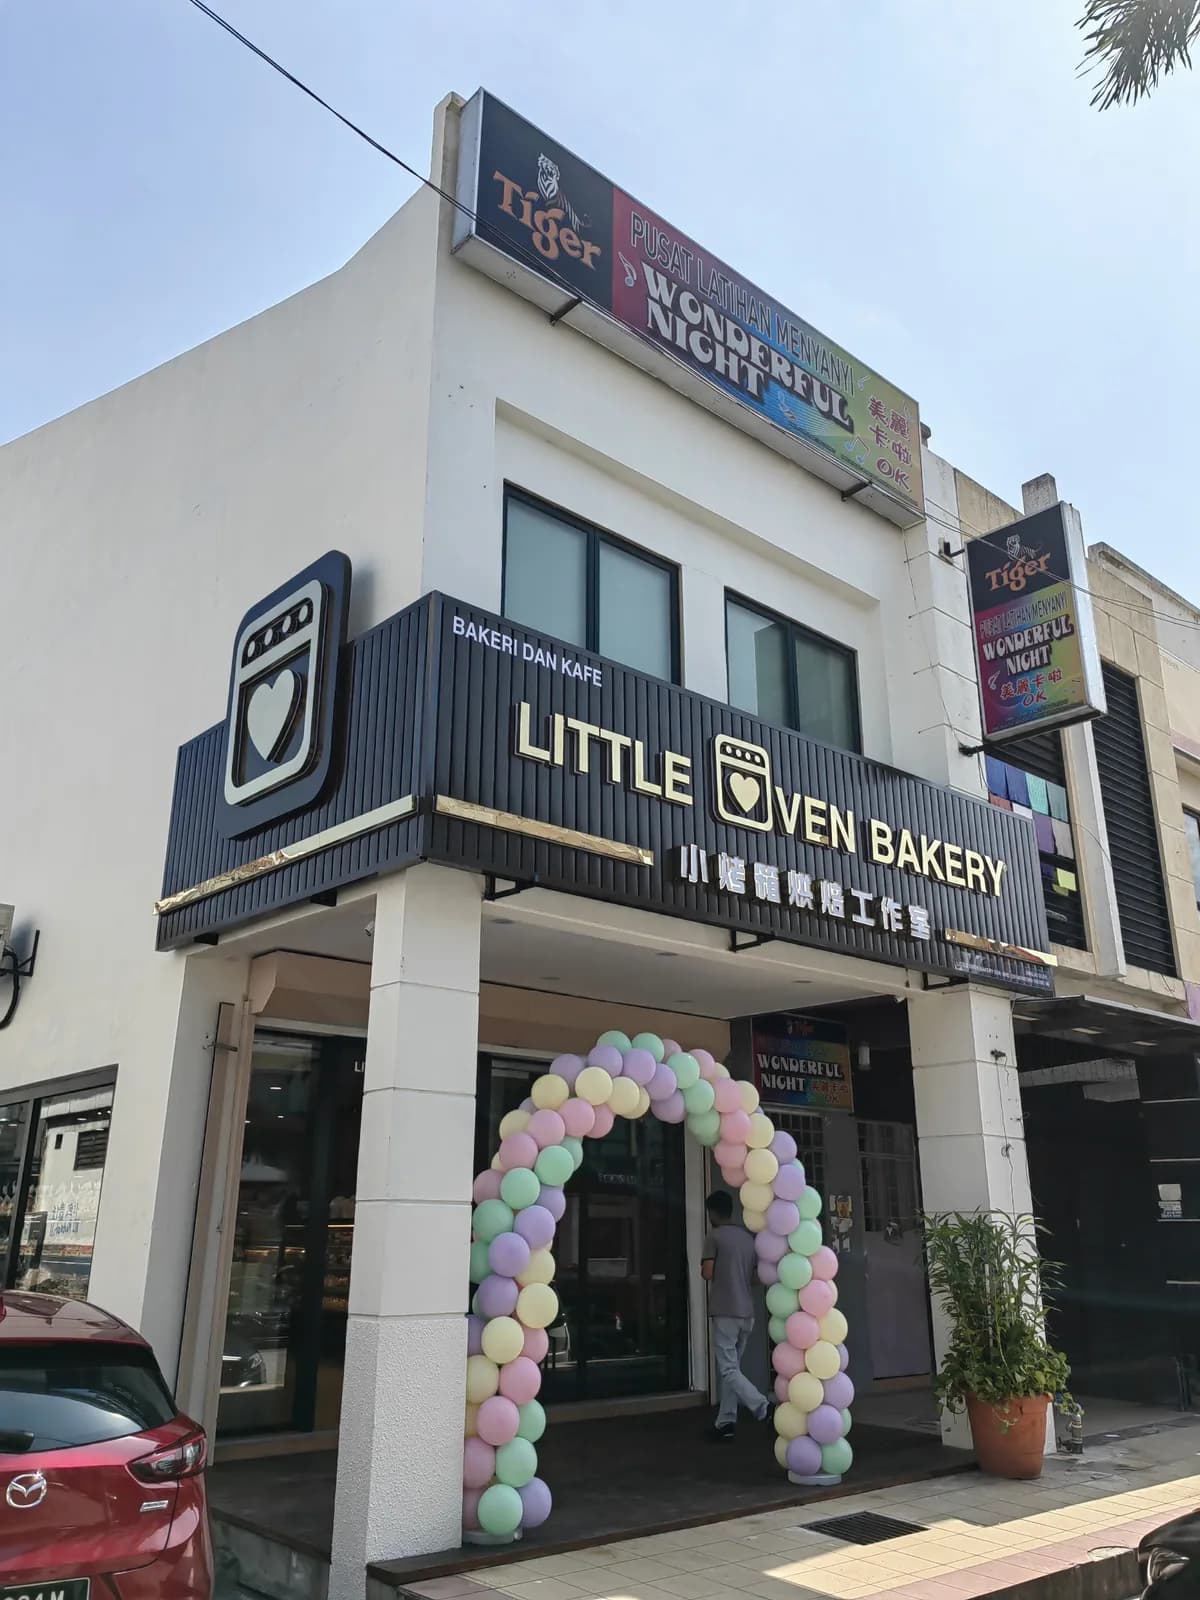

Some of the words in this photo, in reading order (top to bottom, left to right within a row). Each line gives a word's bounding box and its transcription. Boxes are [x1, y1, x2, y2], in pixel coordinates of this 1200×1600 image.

[493, 170, 601, 271] Tiger
[631, 211, 693, 284] PUSAT
[697, 257, 772, 341] LATIHAN
[775, 312, 854, 398] MENYANYI
[642, 261, 853, 428] WONDERFUL
[647, 297, 766, 400] NIGHT
[876, 458, 912, 492] OK
[985, 552, 1051, 592] Tiger
[452, 615, 517, 656] BAKERI
[522, 642, 557, 672] DAN
[561, 658, 602, 688] KAFE
[983, 615, 1072, 661] WONDERFUL
[1006, 644, 1051, 676] NIGHT
[1023, 692, 1047, 707] OK
[514, 701, 693, 806] LITTLE
[869, 818, 1005, 897] BAKERY
[680, 843, 931, 941] 小烤箱烘焙工作室
[757, 1053, 842, 1079] WONDERFUL
[760, 1073, 807, 1092] NIGHT
